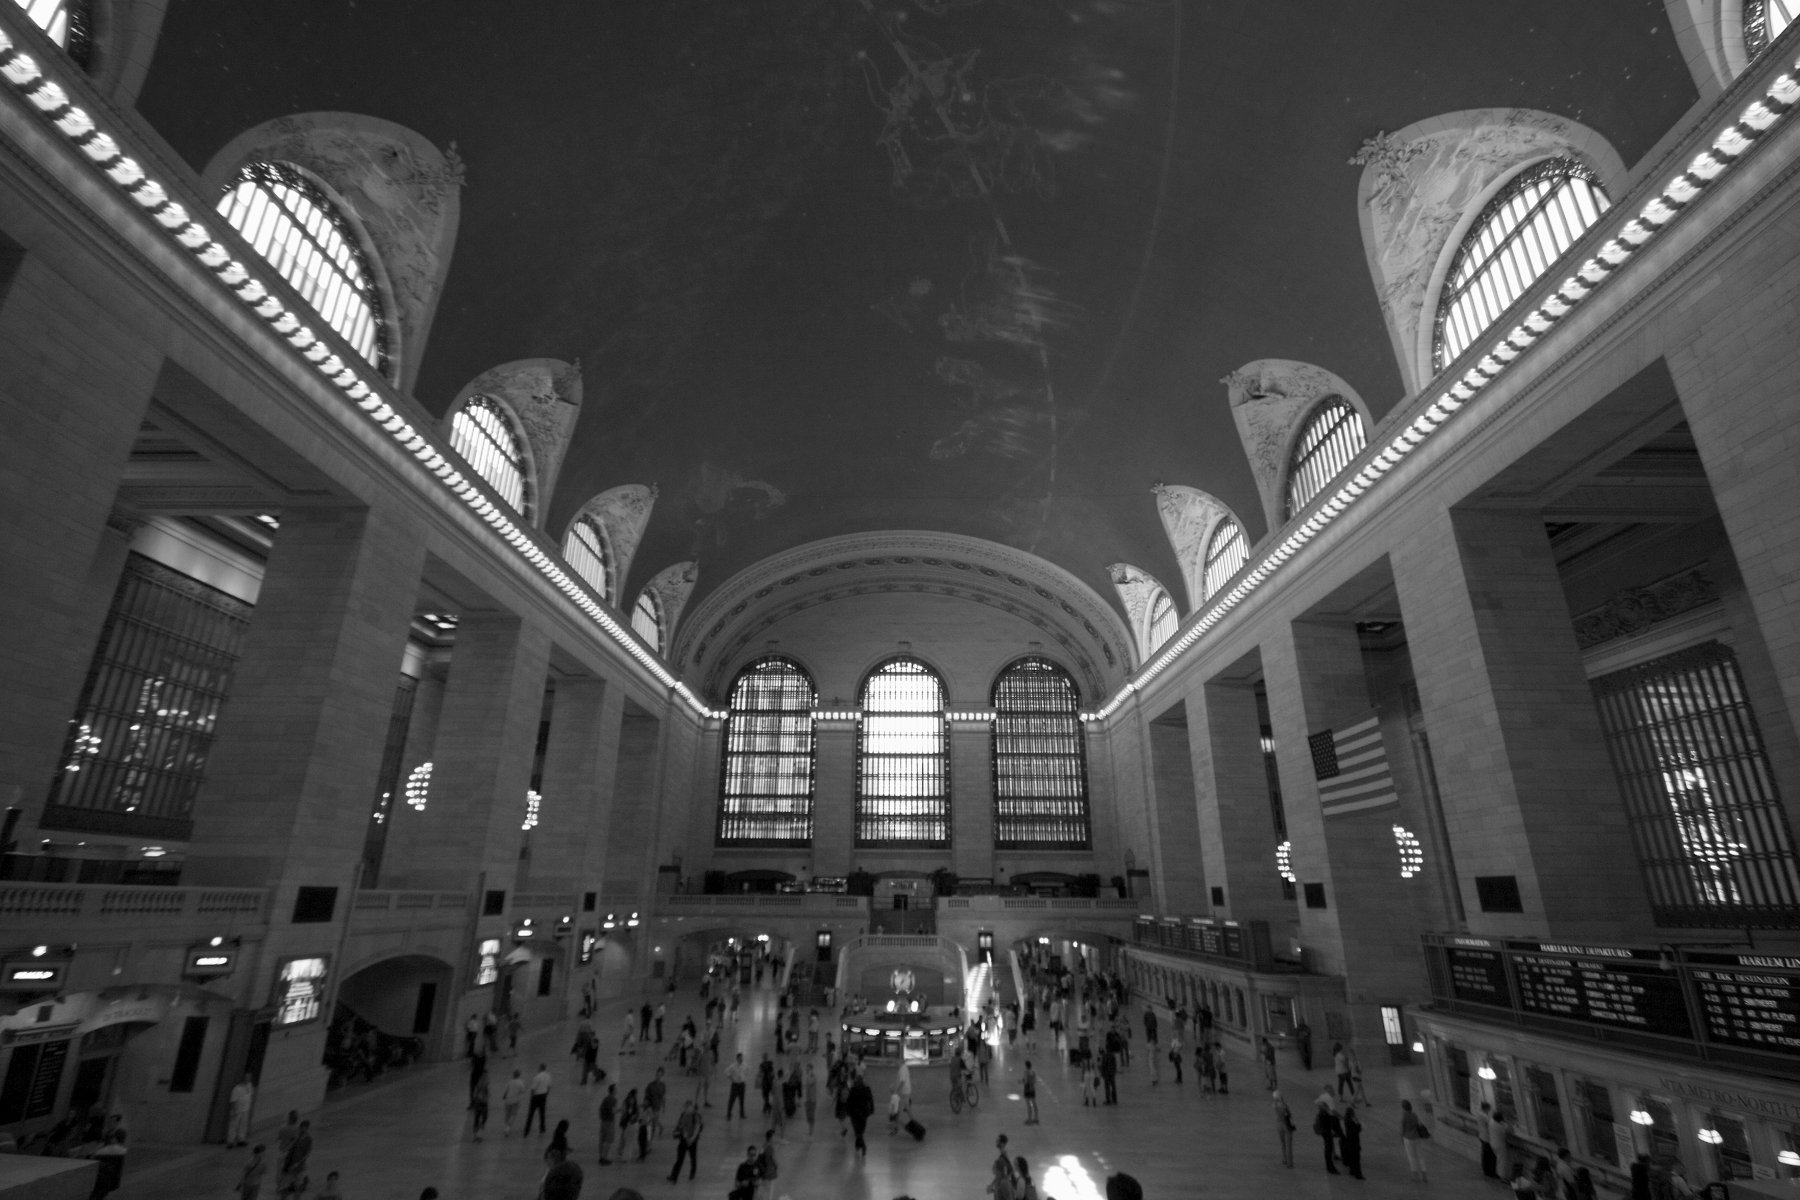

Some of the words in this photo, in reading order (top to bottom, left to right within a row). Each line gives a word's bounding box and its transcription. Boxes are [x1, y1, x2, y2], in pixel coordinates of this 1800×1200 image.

[1454, 938, 1490, 947] INFORMATION
[1539, 943, 1569, 953] HARLEM
[1568, 945, 1585, 954] LINE
[1585, 946, 1634, 958] DEPARTURES
[1537, 958, 1572, 967] DESTINATION
[1577, 961, 1604, 970] REMARKS
[1738, 955, 1785, 968] HARLEM
[1692, 970, 1712, 980] TIME
[1714, 972, 1733, 981] TRK
[1734, 974, 1790, 985] DESTINATION
[1659, 1077, 1687, 1094] MTA
[1687, 1083, 1790, 1117] METRO-NORTH
